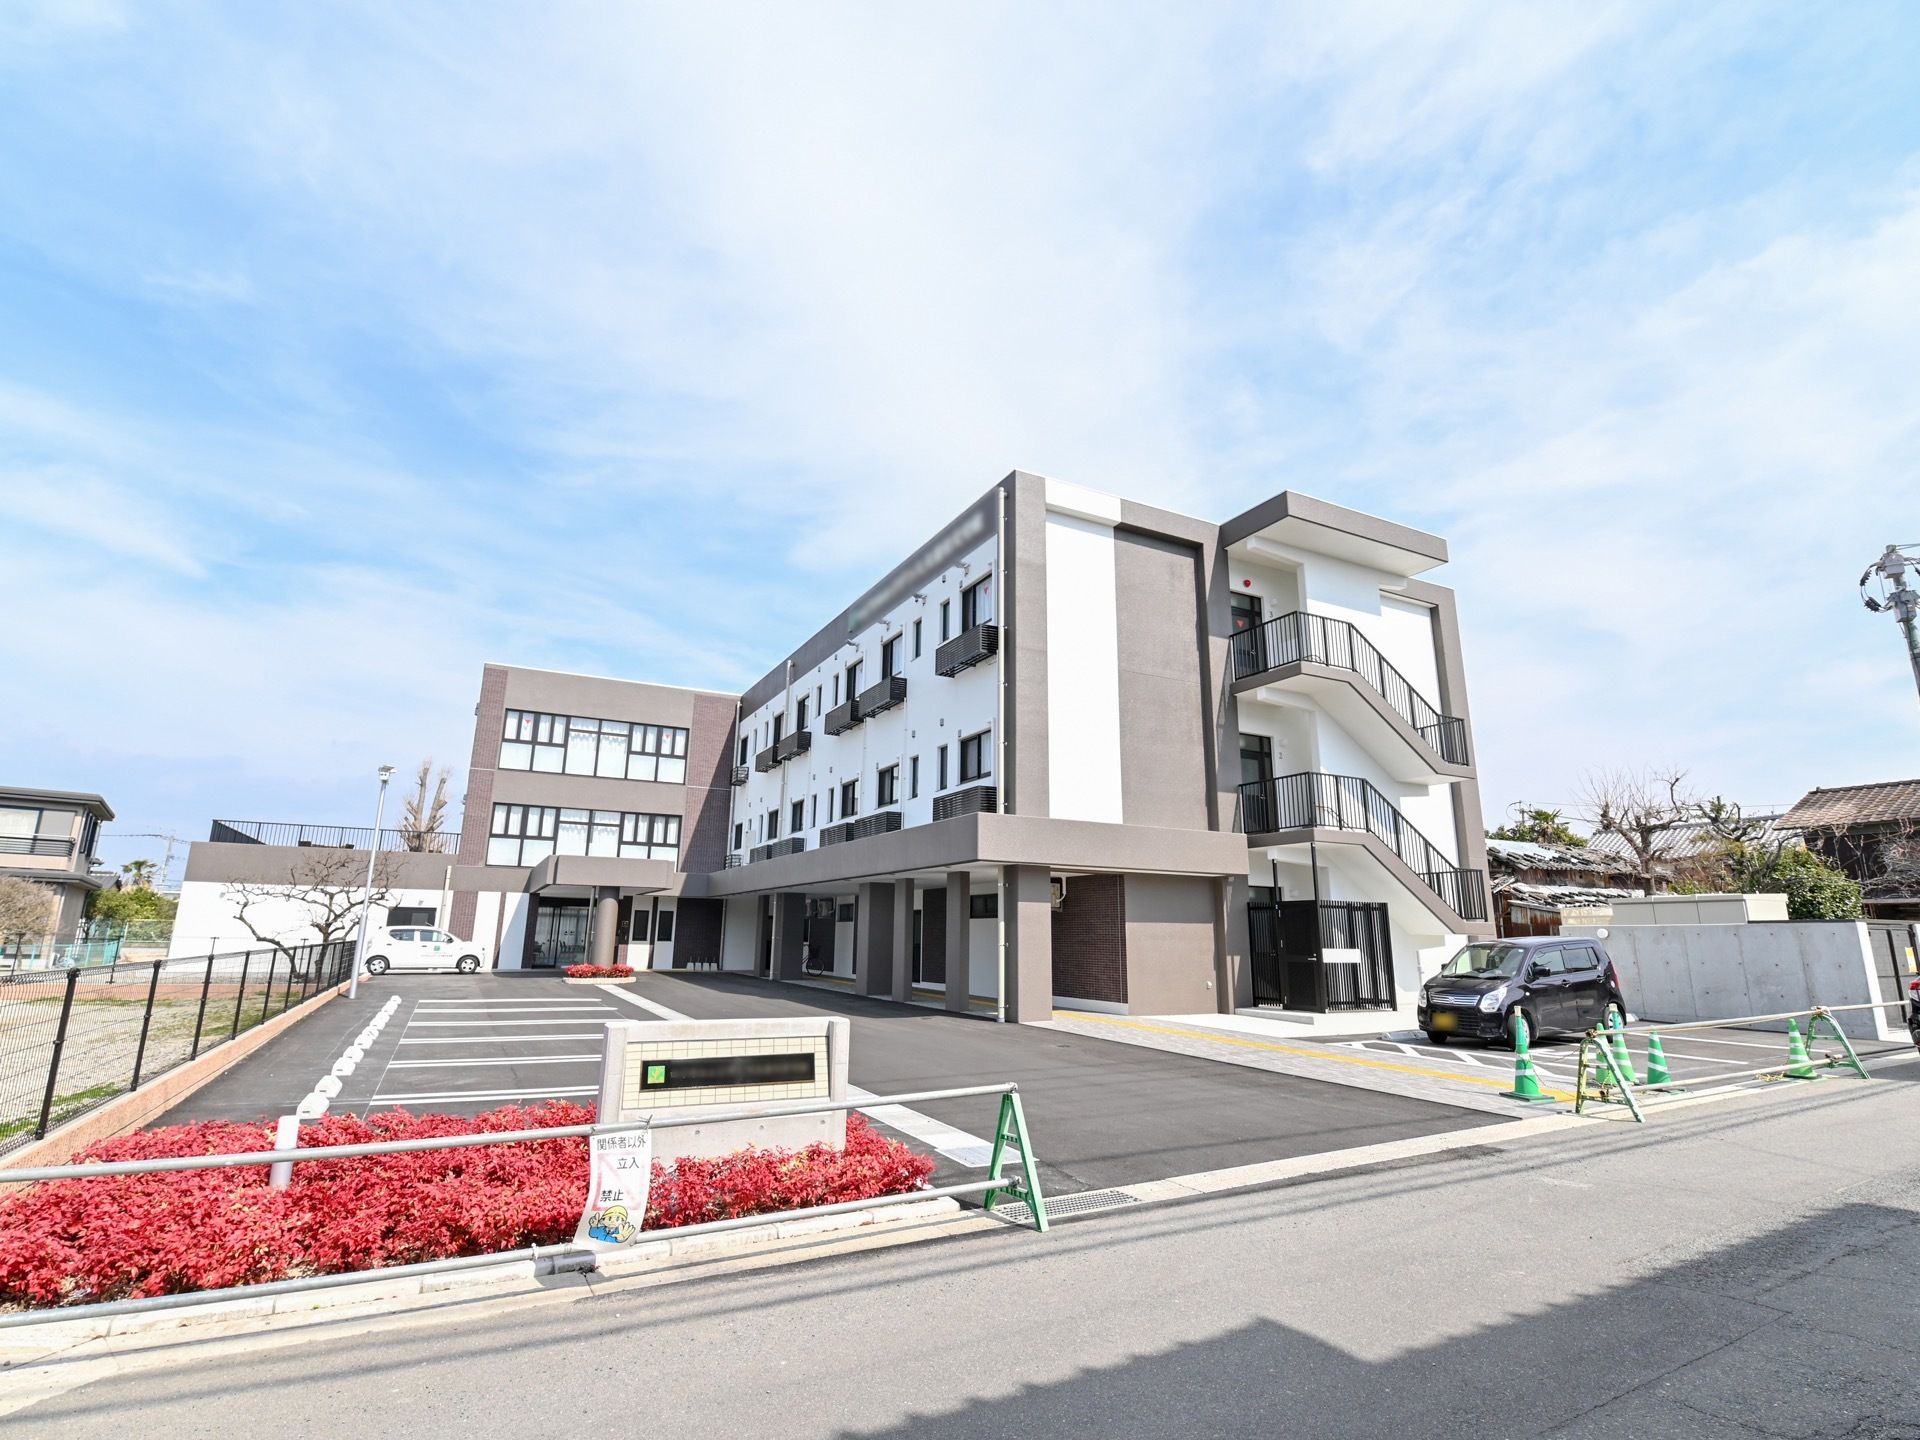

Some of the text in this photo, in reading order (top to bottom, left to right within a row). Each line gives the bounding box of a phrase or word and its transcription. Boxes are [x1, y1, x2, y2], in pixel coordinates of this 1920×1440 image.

[597, 1135, 646, 1150] 関係者以外
[617, 1157, 640, 1169] 立入
[600, 1189, 624, 1202] 禁止
